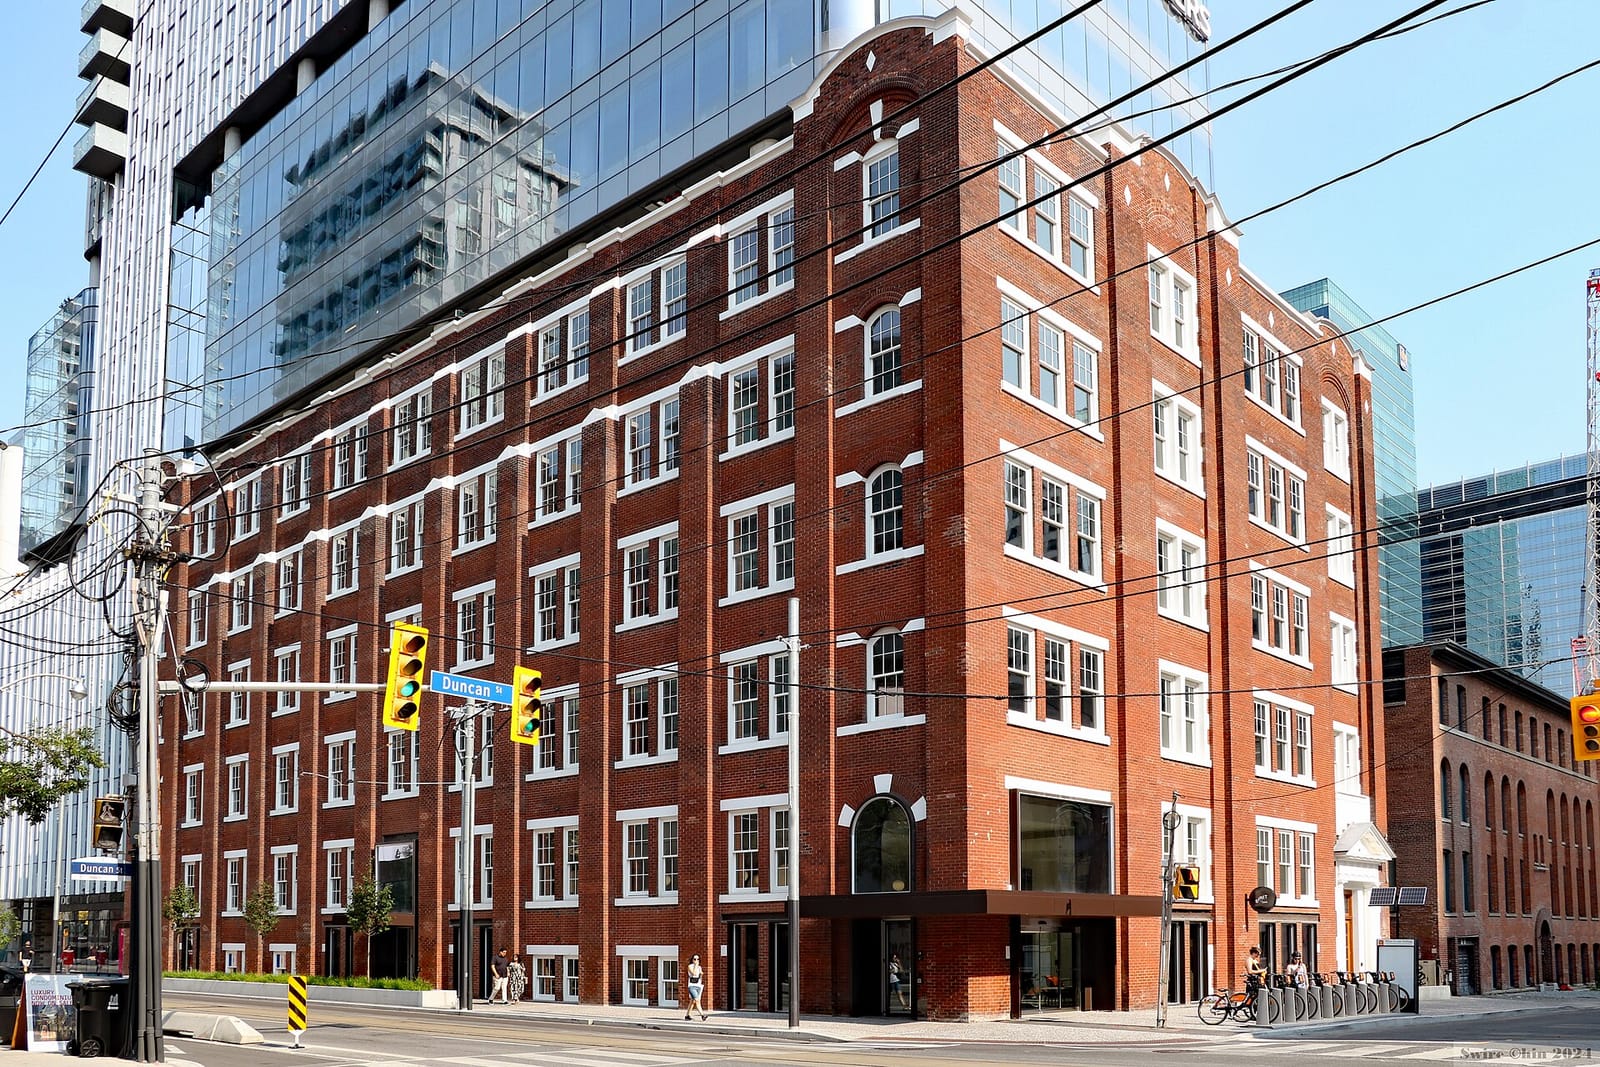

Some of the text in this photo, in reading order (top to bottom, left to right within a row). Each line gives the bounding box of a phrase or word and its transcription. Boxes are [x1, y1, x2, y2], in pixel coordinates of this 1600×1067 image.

[442, 675, 503, 698] Duncan St
[80, 863, 123, 874] Duncan St
